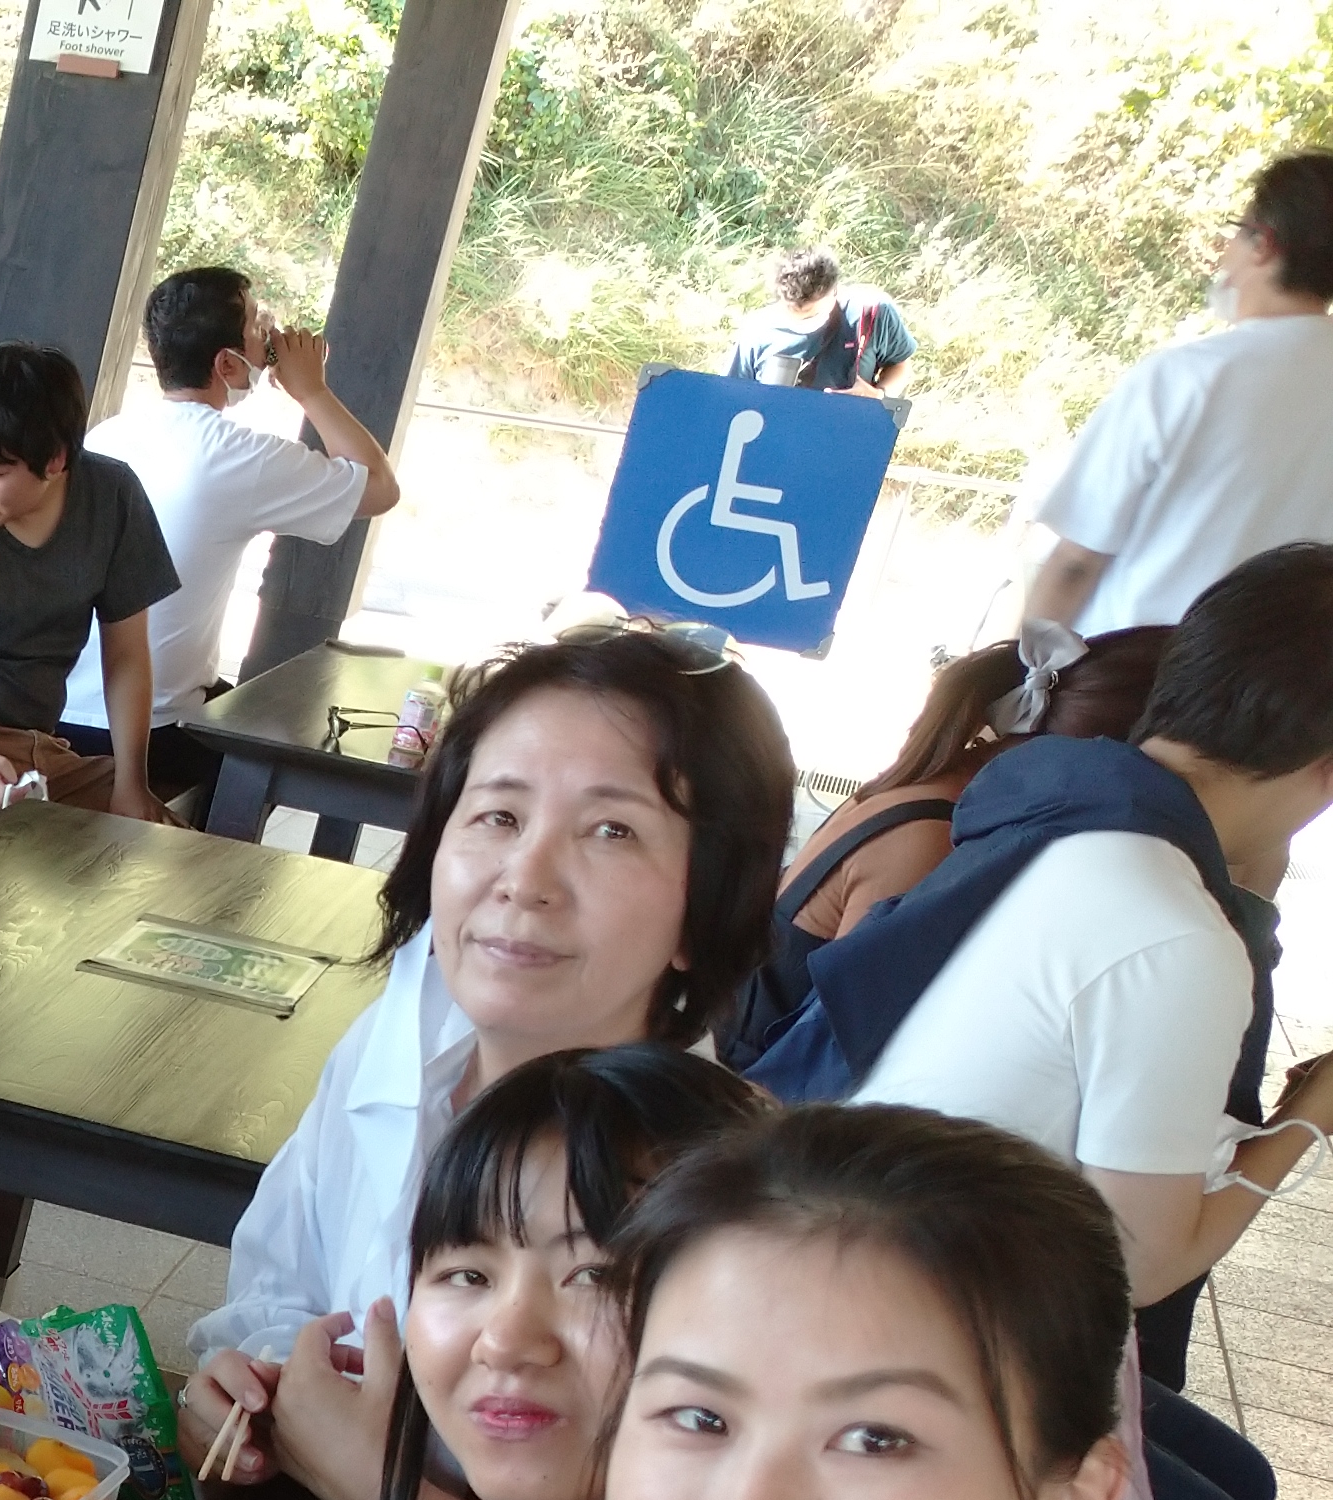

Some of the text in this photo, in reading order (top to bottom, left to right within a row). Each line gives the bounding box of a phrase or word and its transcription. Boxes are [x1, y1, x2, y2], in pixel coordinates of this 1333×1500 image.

[47, 20, 142, 42] 足洗いシャワー
[59, 40, 125, 57] Foot shower
